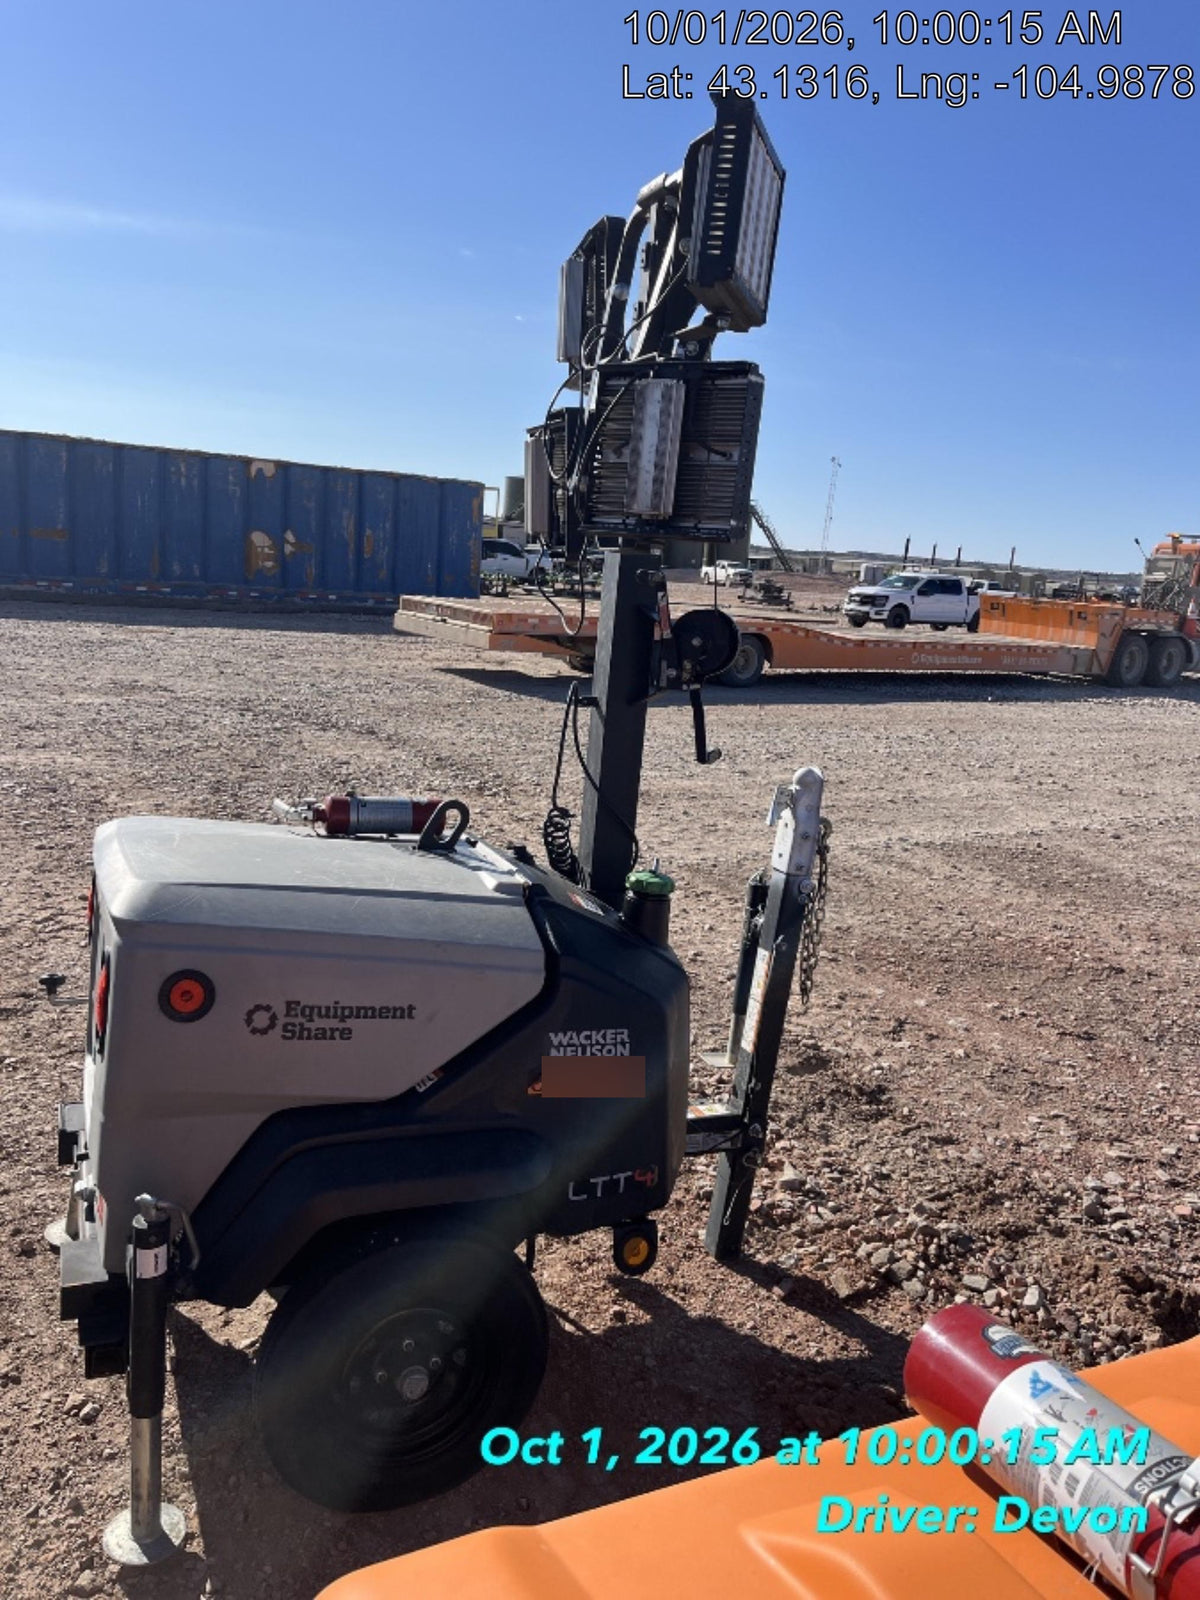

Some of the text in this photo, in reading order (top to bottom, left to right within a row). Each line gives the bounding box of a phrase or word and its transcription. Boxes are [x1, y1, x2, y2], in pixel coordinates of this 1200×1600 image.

[283, 1000, 417, 1023] Equipment
[280, 1022, 353, 1041] Share
[548, 1028, 630, 1046] WACKER
[1134, 1457, 1189, 1494] CTIONS
